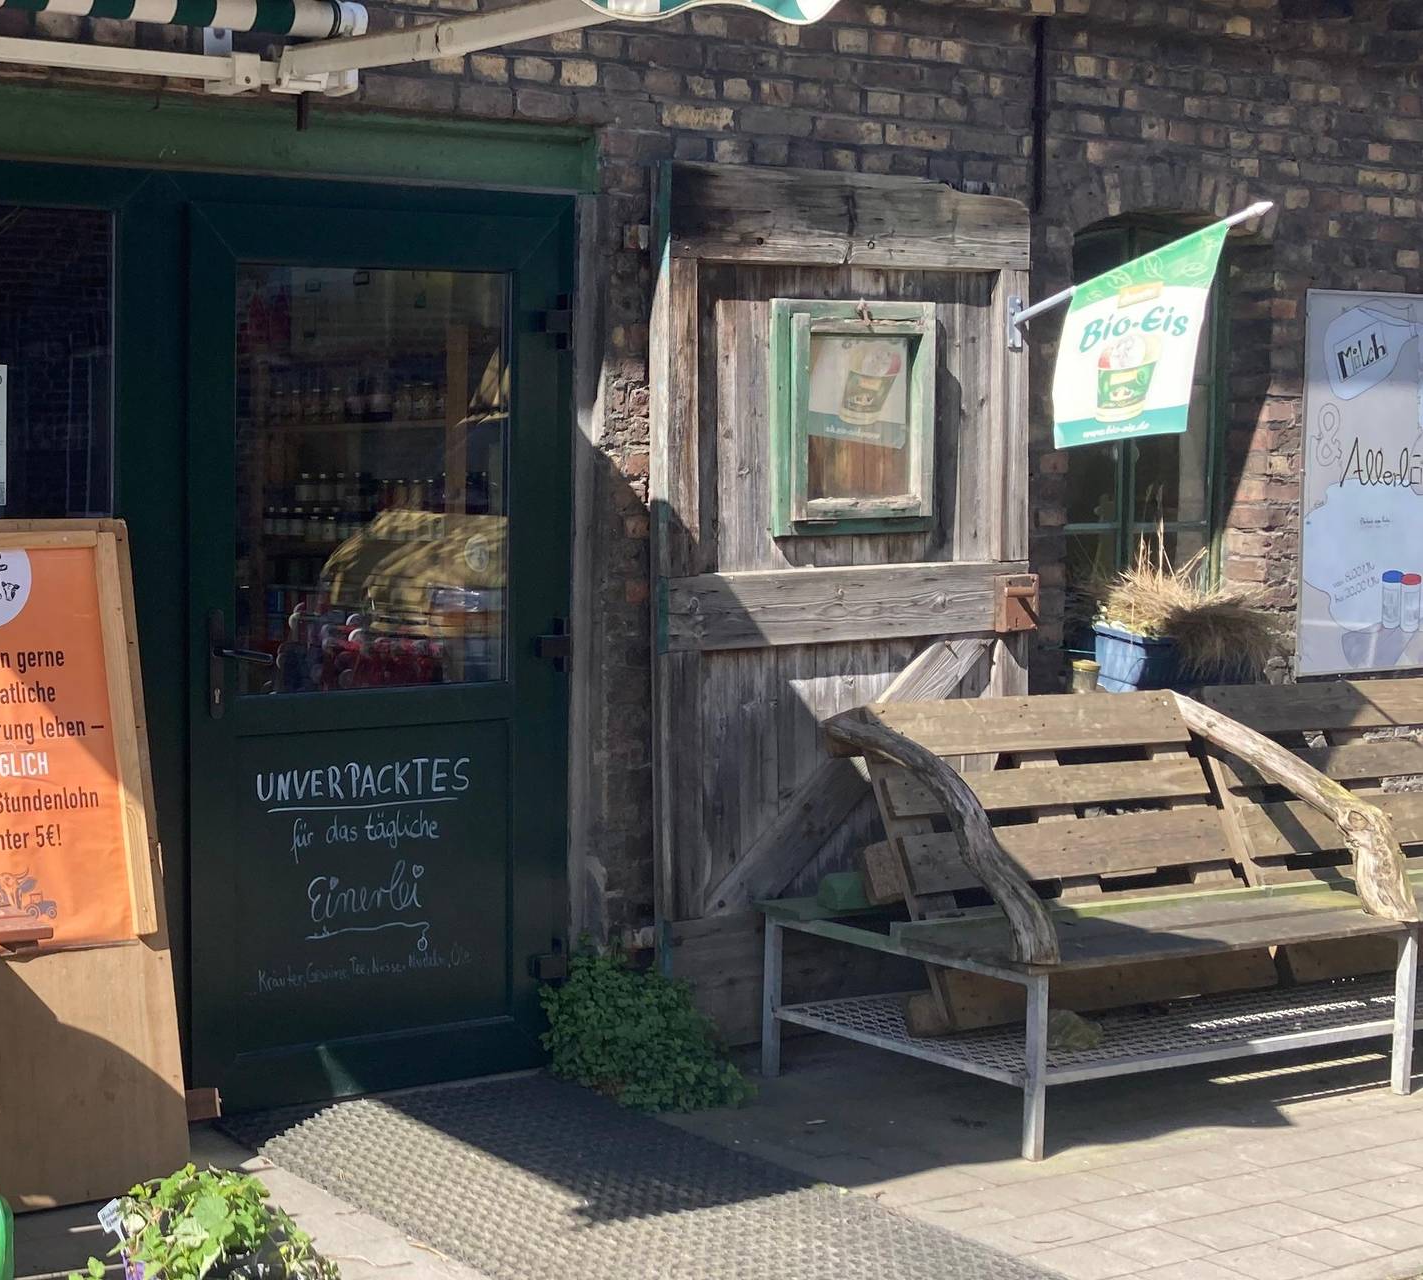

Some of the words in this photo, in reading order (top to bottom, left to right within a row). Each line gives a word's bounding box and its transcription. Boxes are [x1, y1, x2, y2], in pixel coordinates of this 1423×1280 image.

[1079, 306, 1189, 353] Bio-Eis
[17, 650, 64, 673] gerne
[40, 717, 86, 738] leben
[256, 758, 471, 801] UNVERPACKTES
[36, 824, 62, 847] 5€!
[291, 818, 314, 864] für
[327, 815, 358, 843] das
[365, 810, 440, 848] tägliche
[307, 860, 425, 922] Einerlei
